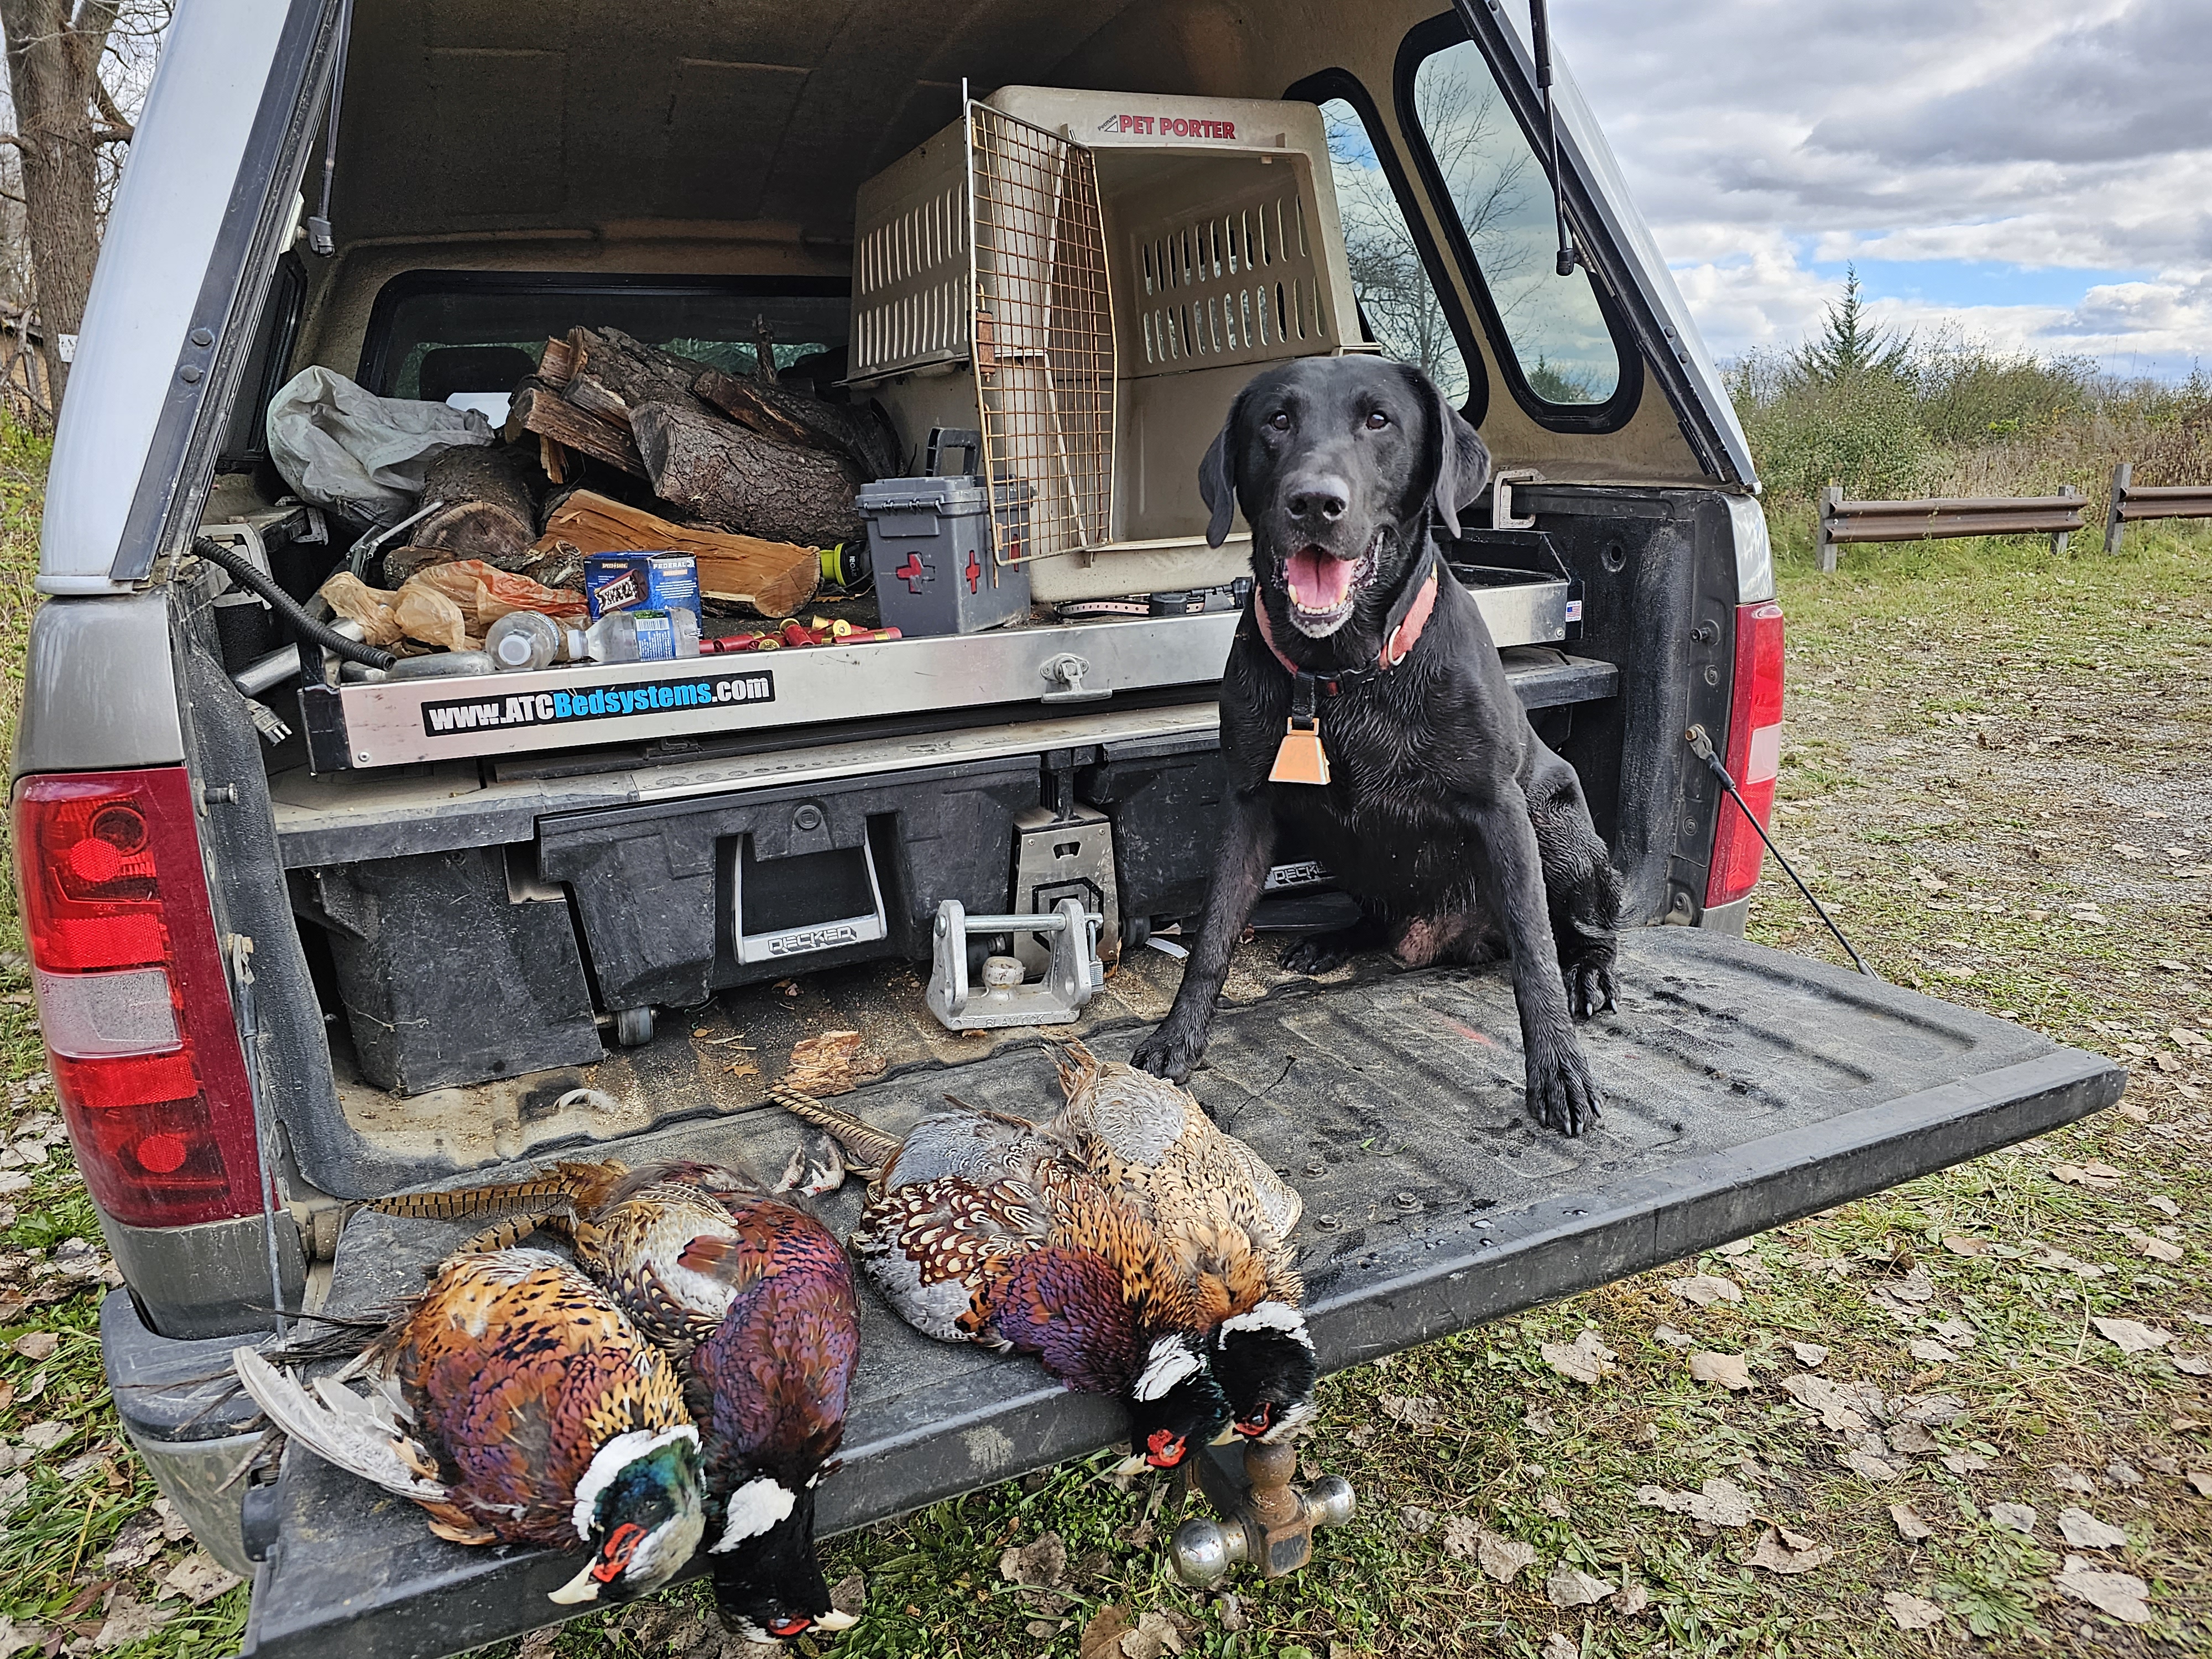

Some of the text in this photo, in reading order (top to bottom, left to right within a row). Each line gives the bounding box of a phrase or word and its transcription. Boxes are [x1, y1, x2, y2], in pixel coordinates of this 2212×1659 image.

[1097, 114, 1117, 132] Petmate
[1119, 114, 1236, 139] PET PORTER
[653, 561, 686, 570] FEDERAL
[429, 677, 769, 731] www.ATCBedsystems.com
[768, 926, 857, 954] DECKED
